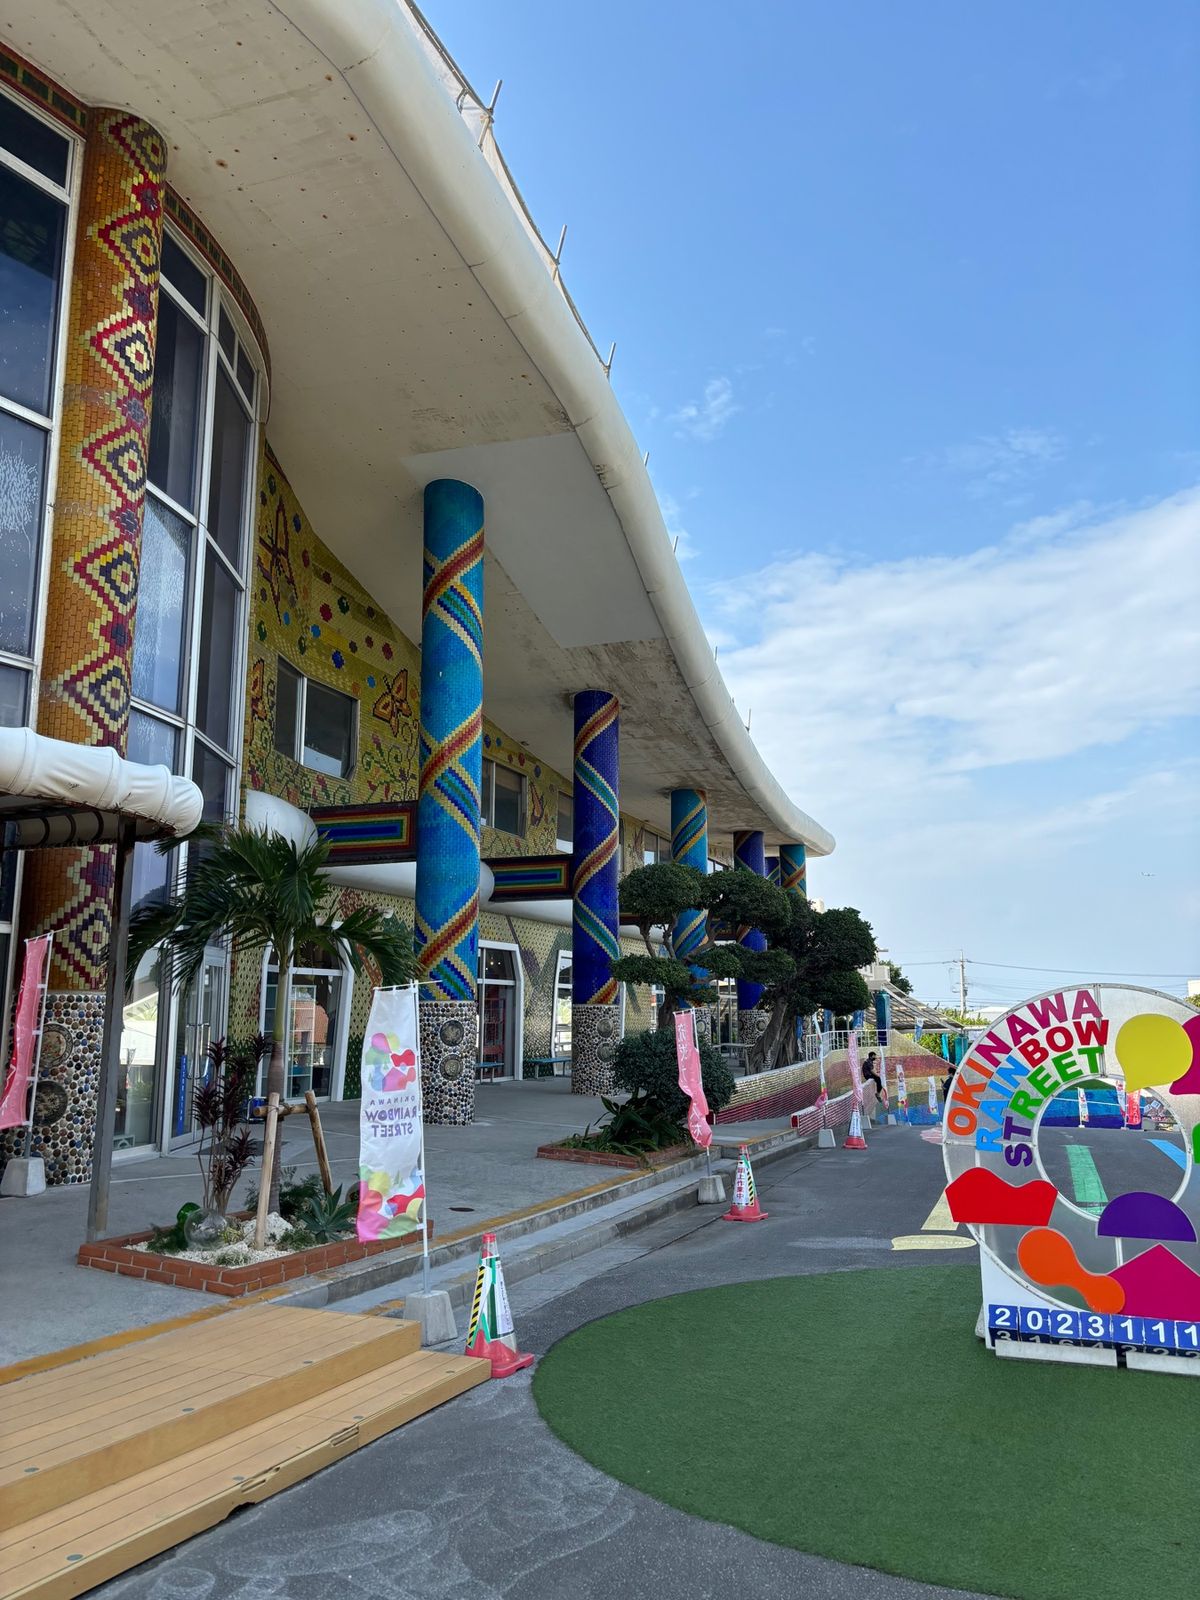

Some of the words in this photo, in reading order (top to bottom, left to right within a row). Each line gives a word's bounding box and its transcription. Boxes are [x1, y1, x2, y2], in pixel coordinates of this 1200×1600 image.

[947, 990, 1103, 1136] OKINAWA
[976, 1019, 1109, 1153] RAINBOW
[1005, 1046, 1102, 1167] STREET
